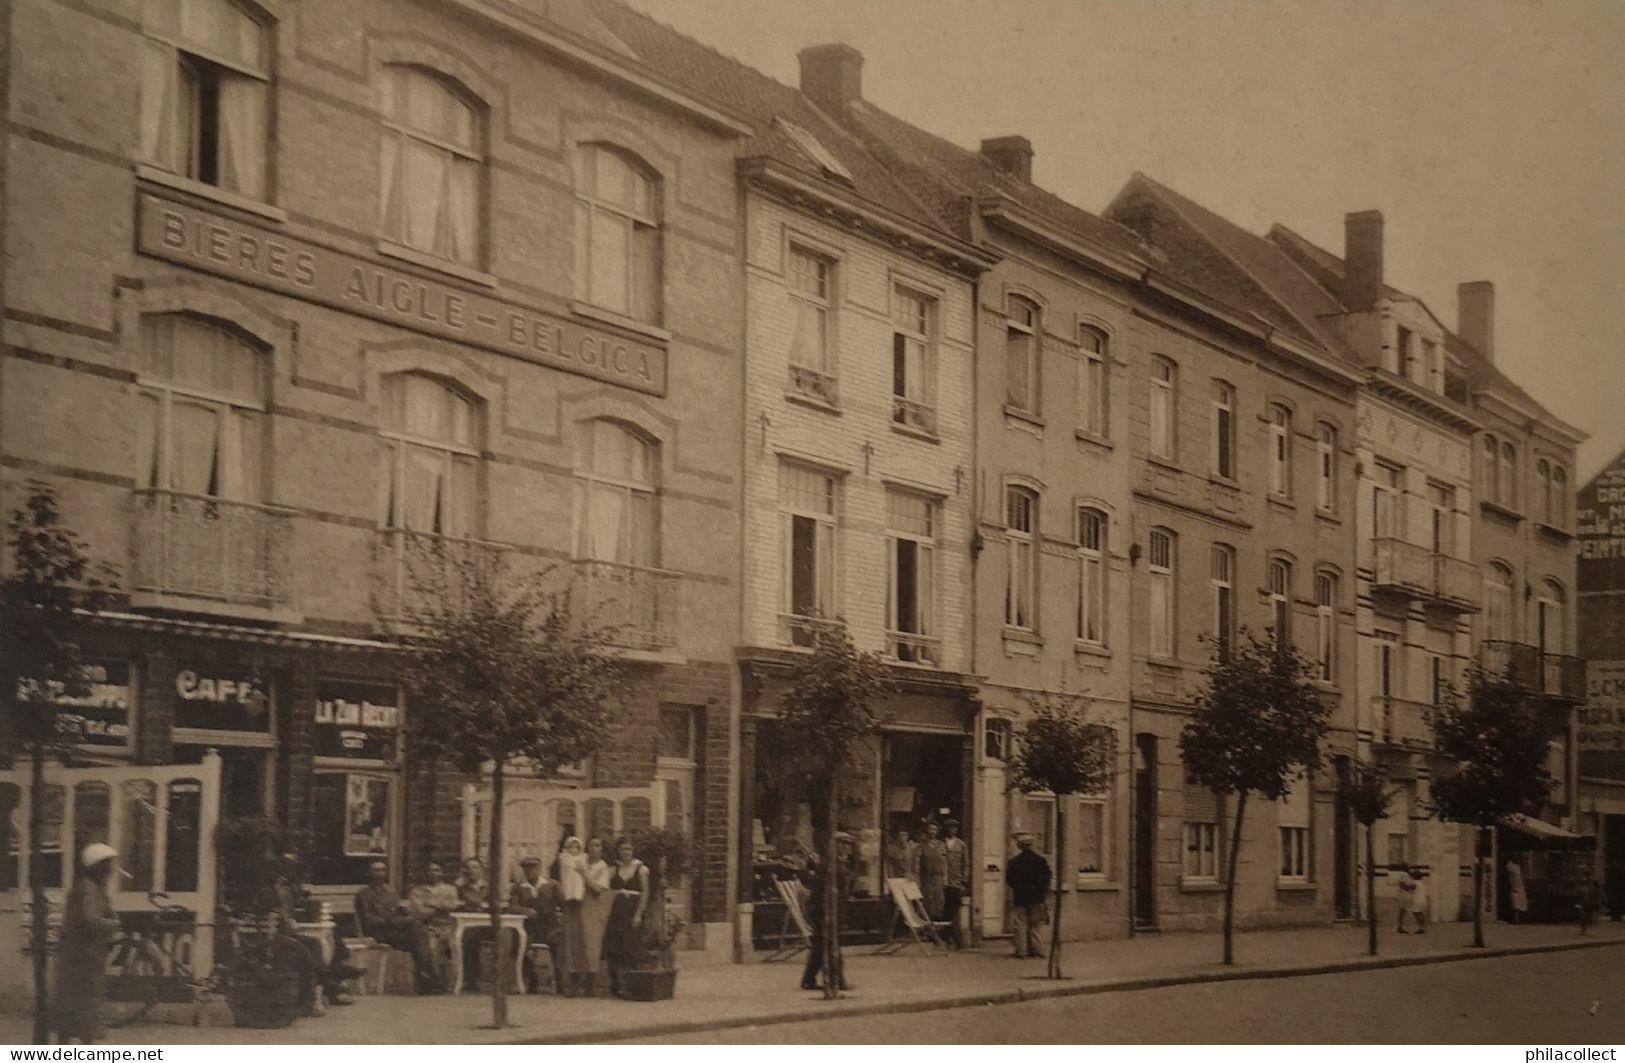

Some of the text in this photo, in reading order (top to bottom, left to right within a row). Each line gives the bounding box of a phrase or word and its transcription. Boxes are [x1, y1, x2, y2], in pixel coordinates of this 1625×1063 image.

[161, 209, 316, 289] BIERES
[342, 266, 466, 329] AIGLE
[507, 312, 654, 384] BELGICA
